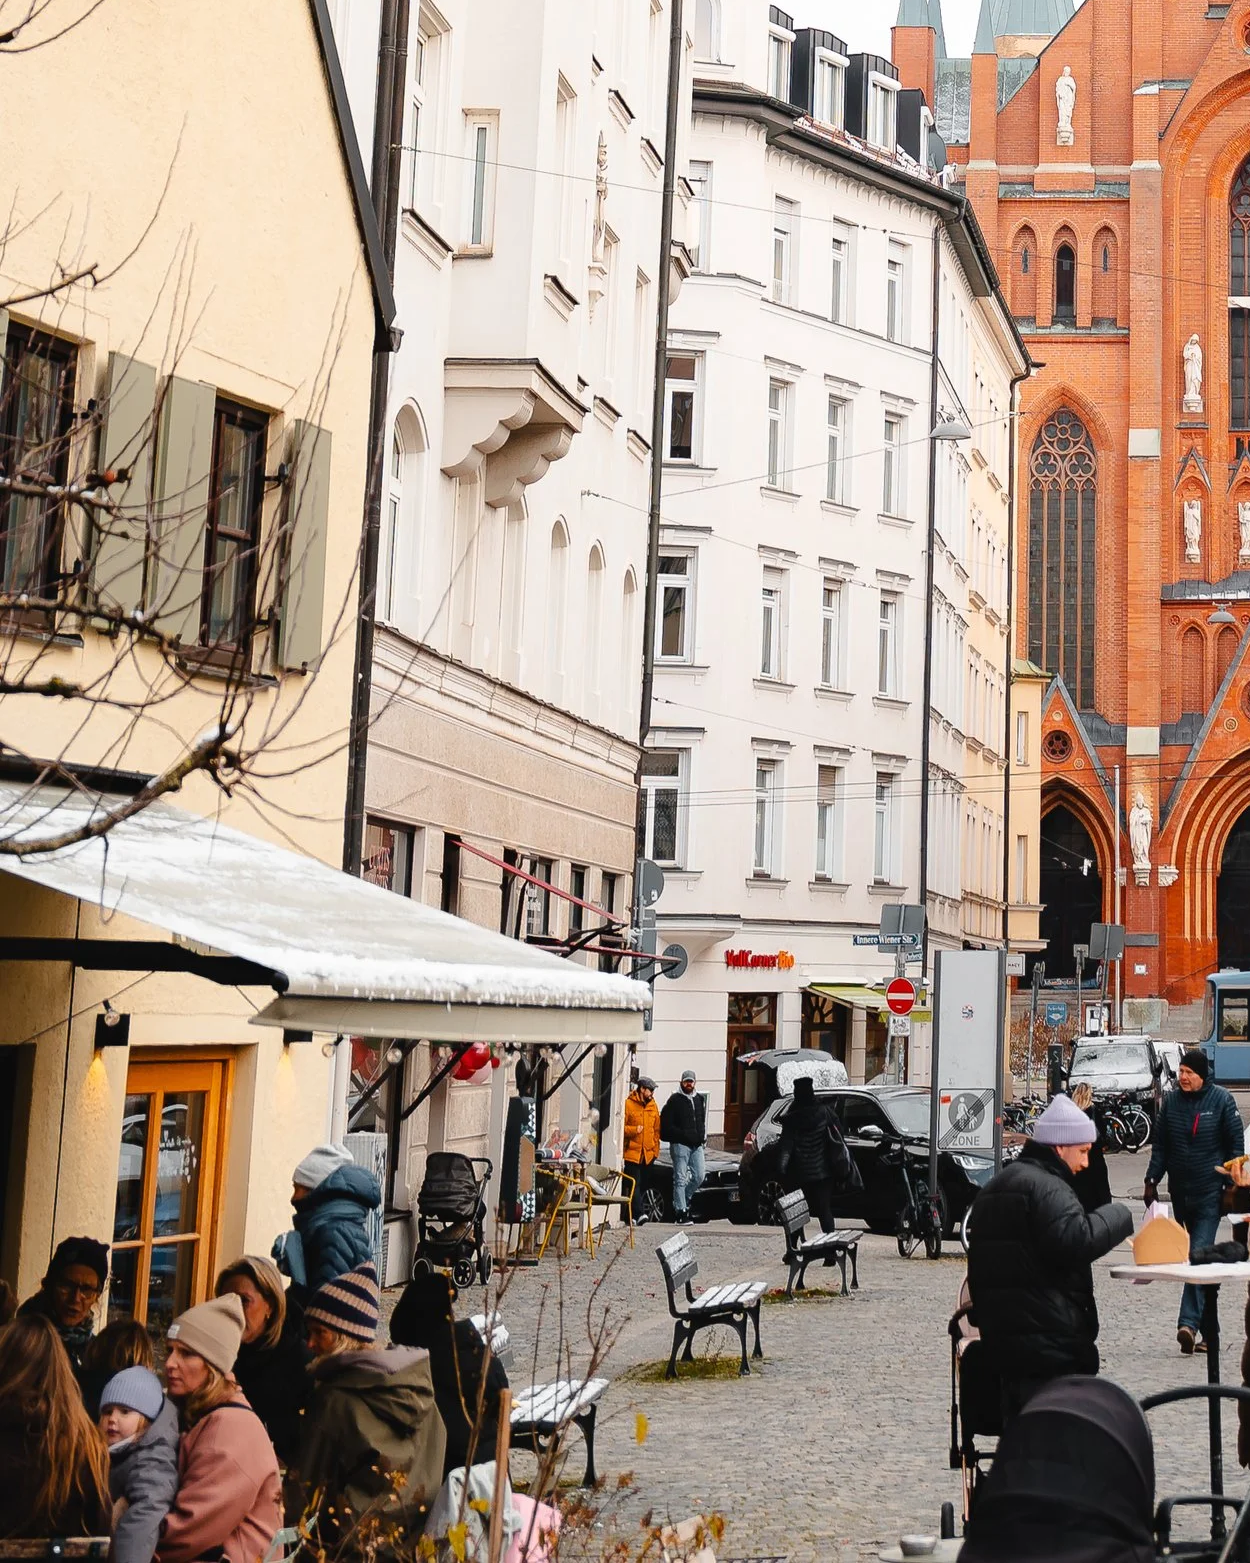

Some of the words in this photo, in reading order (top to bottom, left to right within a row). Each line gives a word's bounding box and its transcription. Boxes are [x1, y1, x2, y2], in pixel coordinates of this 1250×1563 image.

[857, 934, 878, 943] Innere
[879, 933, 901, 944] Wiener
[902, 934, 913, 943] Str.
[952, 1136, 980, 1146] ZONE
